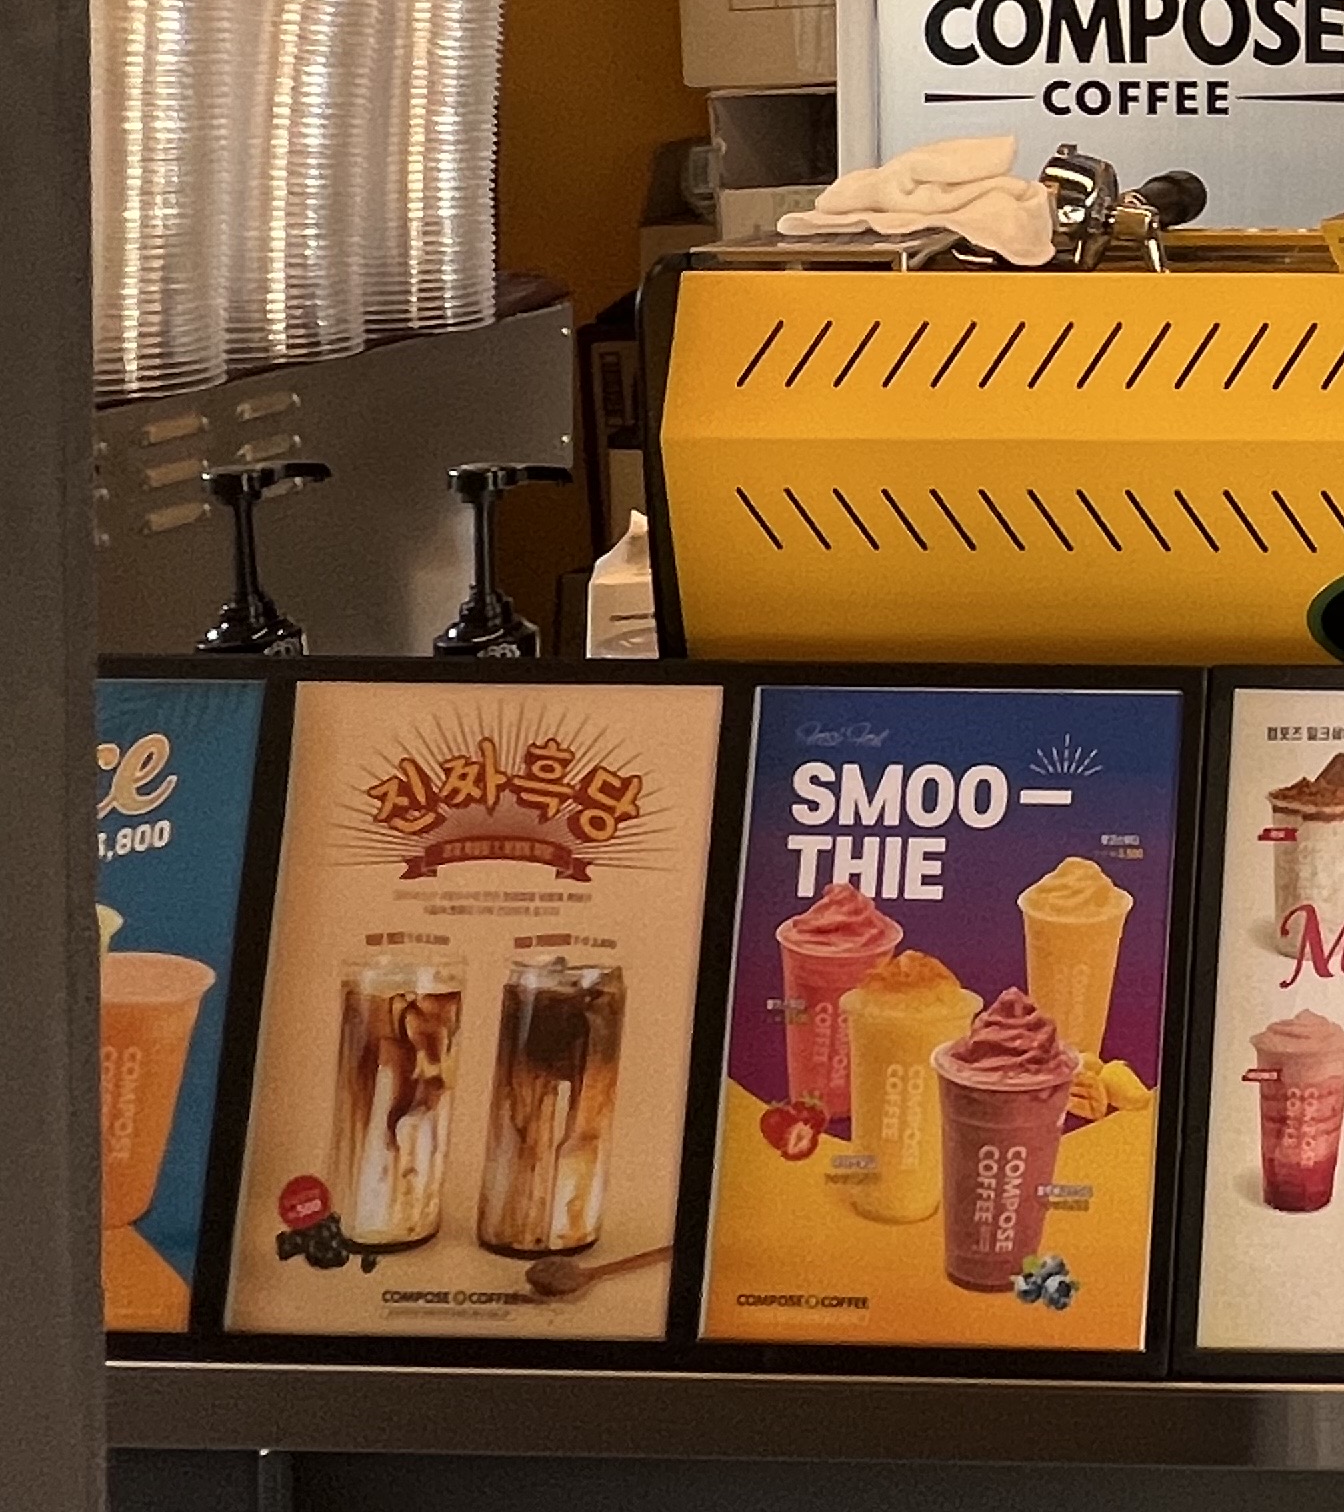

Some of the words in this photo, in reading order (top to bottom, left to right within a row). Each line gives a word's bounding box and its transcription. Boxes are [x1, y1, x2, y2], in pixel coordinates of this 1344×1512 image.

[1042, 80, 1230, 116] COFFEE
[367, 736, 644, 844] 진짜흑당
[787, 834, 946, 902] THIE
[973, 1144, 999, 1223] COFFEE
[996, 1146, 1028, 1254] COMPOSE
[382, 1290, 450, 1305] COMPOSE
[820, 1295, 869, 1310] COFFEE
